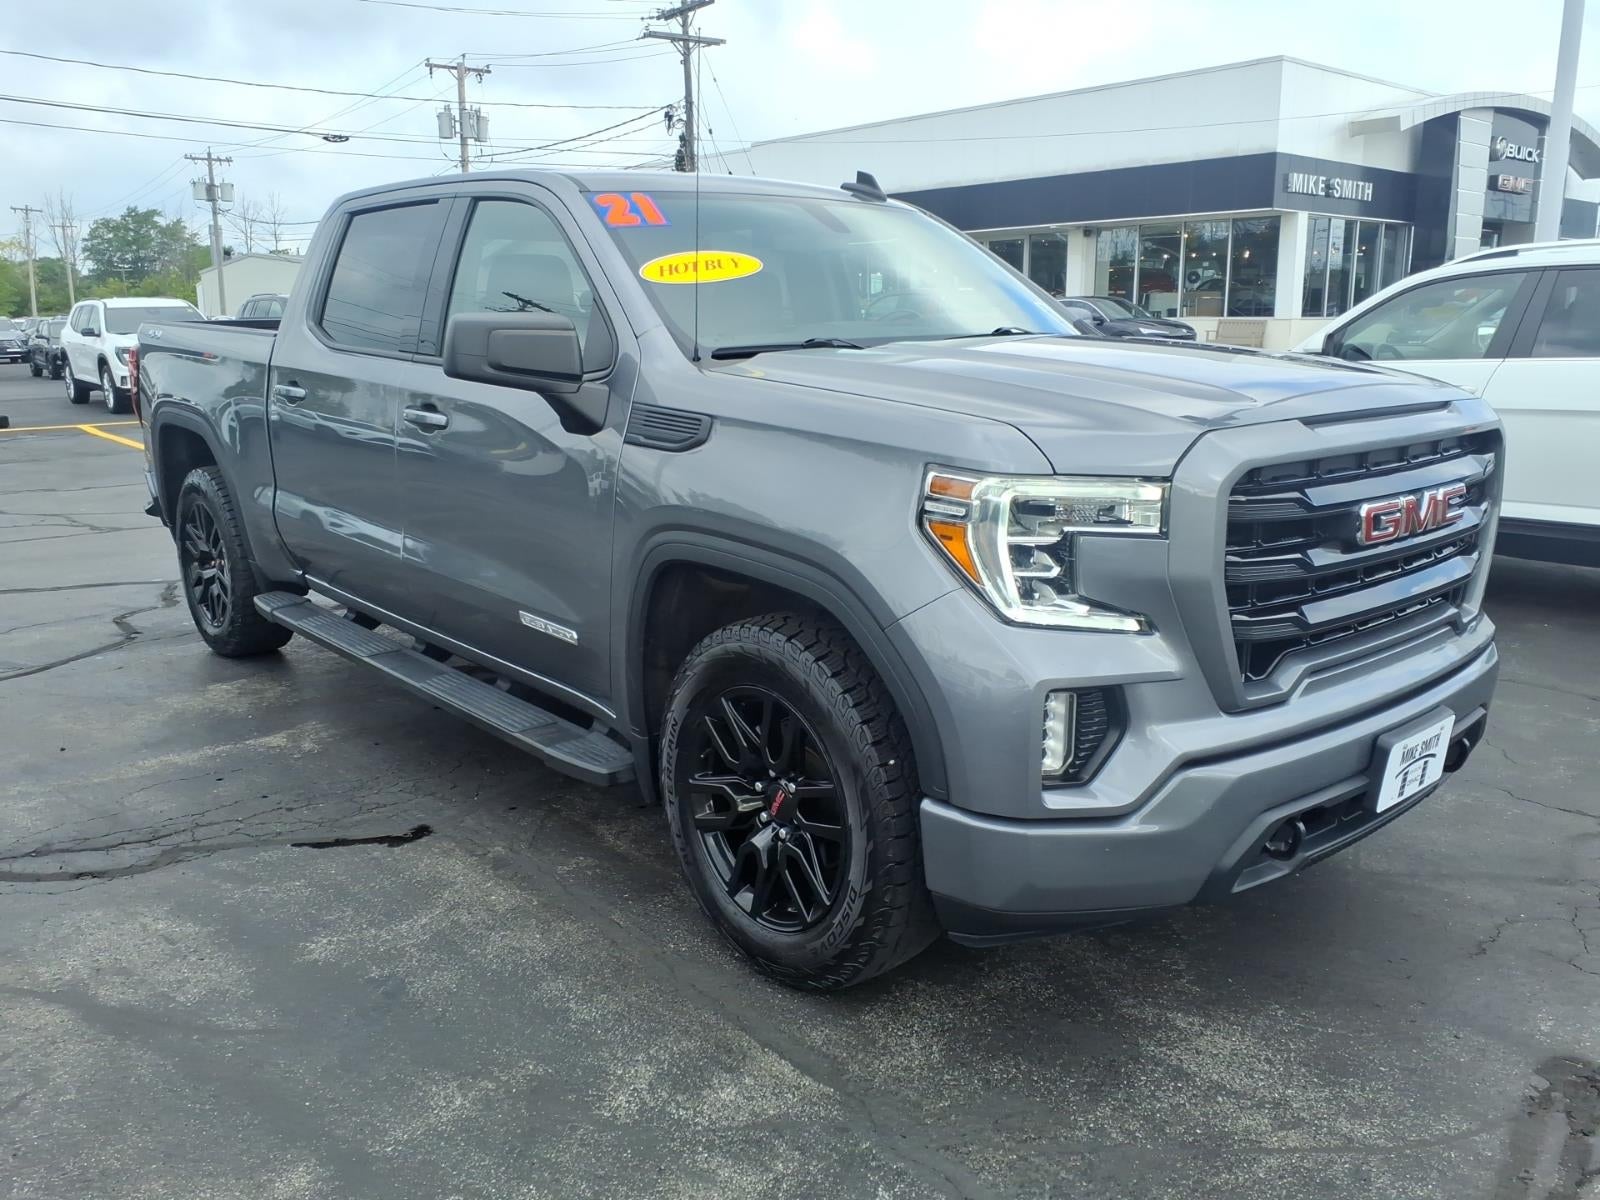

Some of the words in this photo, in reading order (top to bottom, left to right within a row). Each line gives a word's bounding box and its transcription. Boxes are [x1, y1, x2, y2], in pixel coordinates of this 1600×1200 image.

[1505, 143, 1541, 163] BUICK
[1288, 172, 1326, 196] MIKE
[1333, 177, 1374, 202] SMITH
[593, 192, 667, 227] 21
[659, 259, 700, 278] HOT
[704, 256, 743, 272] BUY
[1359, 482, 1468, 546] GMC
[1400, 743, 1420, 767] MIKE
[1419, 732, 1442, 758] SMITH
